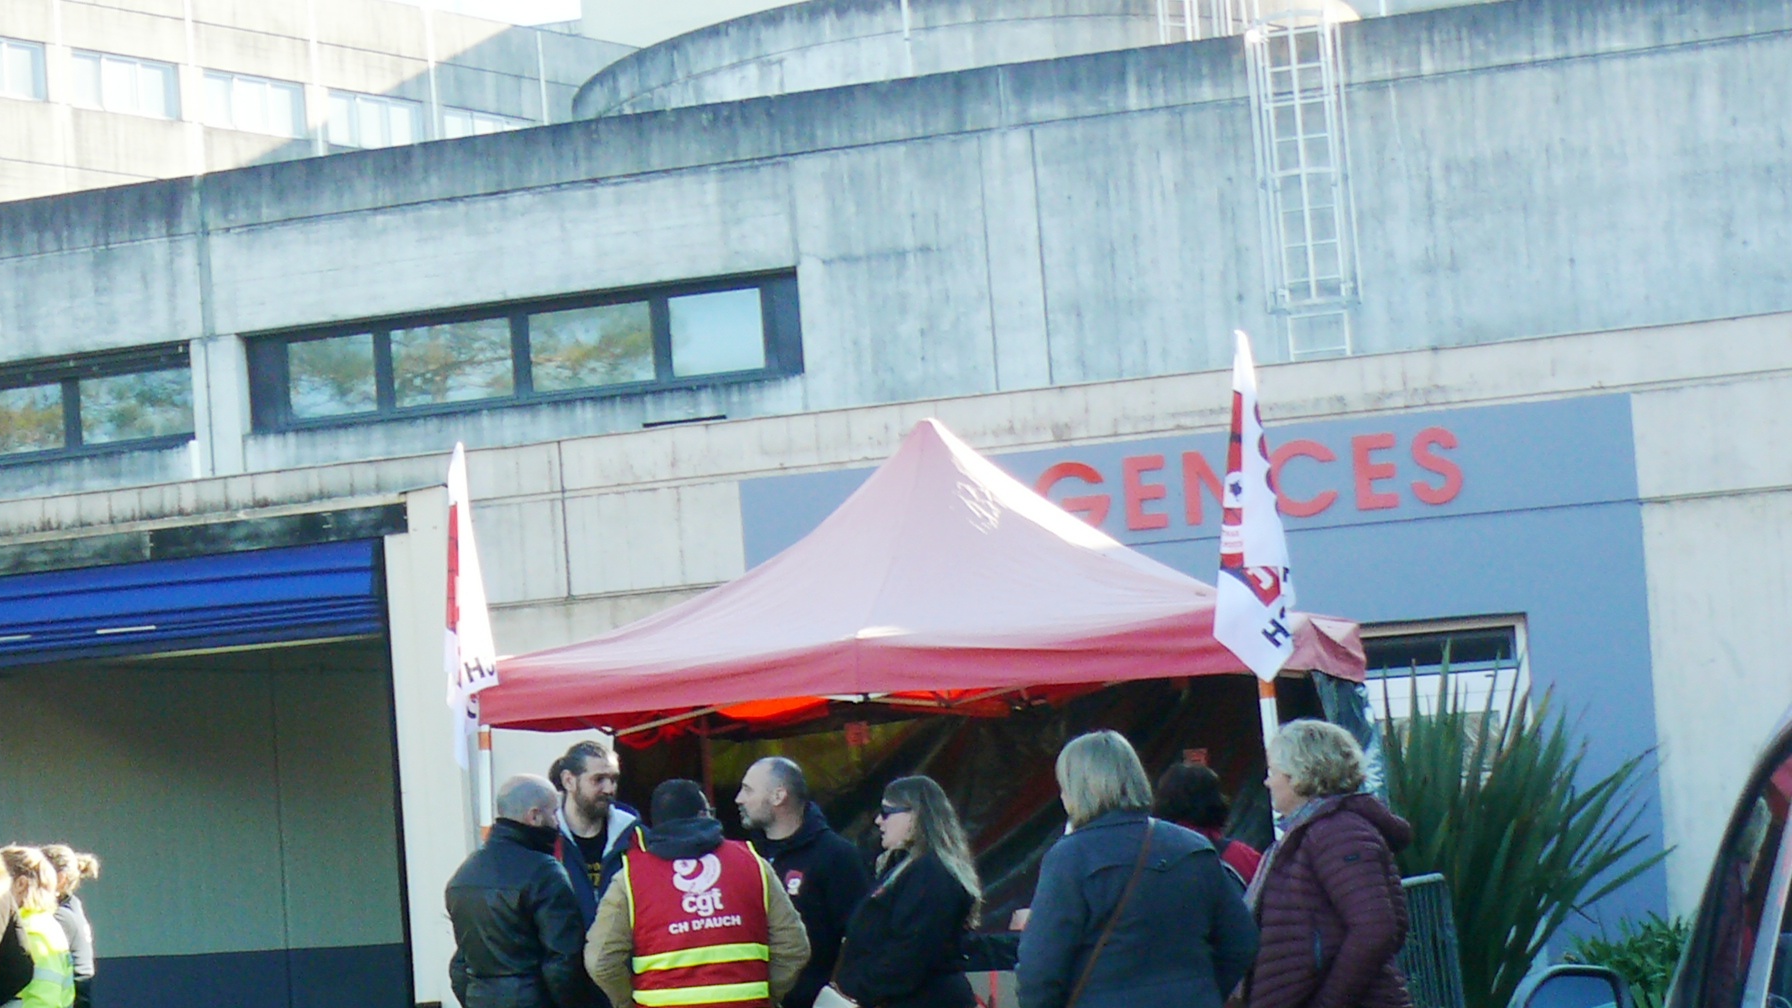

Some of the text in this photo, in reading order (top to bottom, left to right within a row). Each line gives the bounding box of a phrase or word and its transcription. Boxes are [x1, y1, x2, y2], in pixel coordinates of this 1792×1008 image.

[1034, 427, 1463, 532] GENCES
[682, 888, 724, 917] cgt
[669, 915, 742, 935] CH D'AUCH
